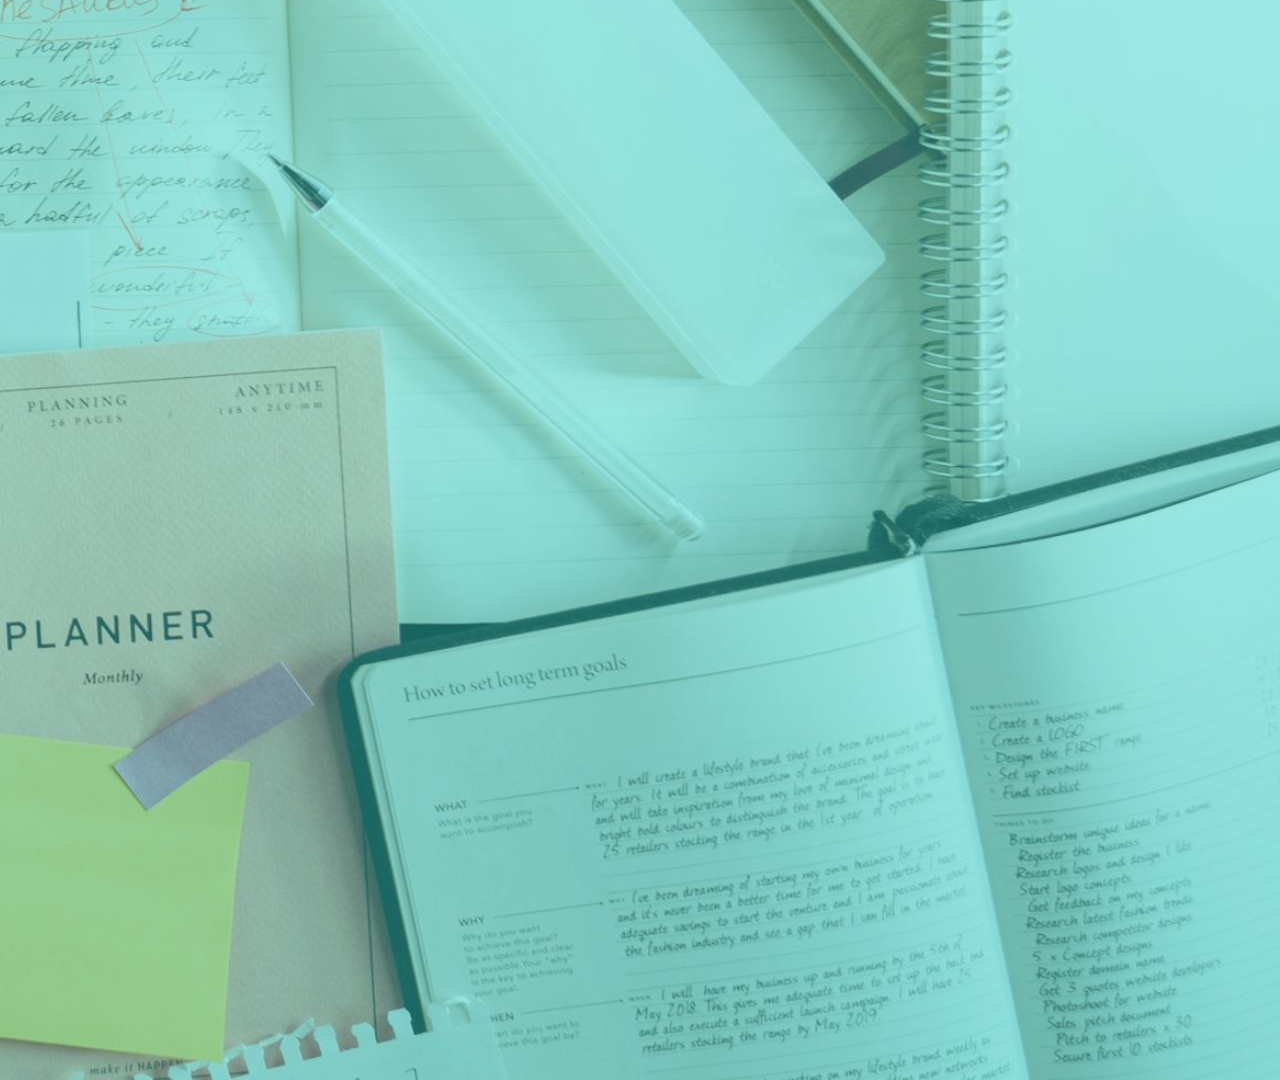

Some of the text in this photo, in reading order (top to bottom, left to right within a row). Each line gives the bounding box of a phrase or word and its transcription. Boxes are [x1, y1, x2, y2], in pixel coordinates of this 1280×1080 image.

[234, 380, 324, 398] ANYTIME
[28, 394, 128, 413] PLANNING
[267, 402, 291, 413] 210
[300, 401, 324, 410] mm
[74, 414, 123, 426] PAGES
[6, 609, 216, 651] PLANNER
[83, 667, 143, 686] Monthly
[403, 654, 627, 703] How to set long term goals
[988, 703, 1124, 730] Create business name
[992, 724, 1084, 746] Create LOGO
[999, 762, 1091, 781] Set up website
[1003, 780, 1081, 799] Find stockist
[434, 800, 467, 812] WHAT
[458, 916, 485, 926] WHY
[90, 1064, 119, 1074] make
[125, 1062, 133, 1072] it
